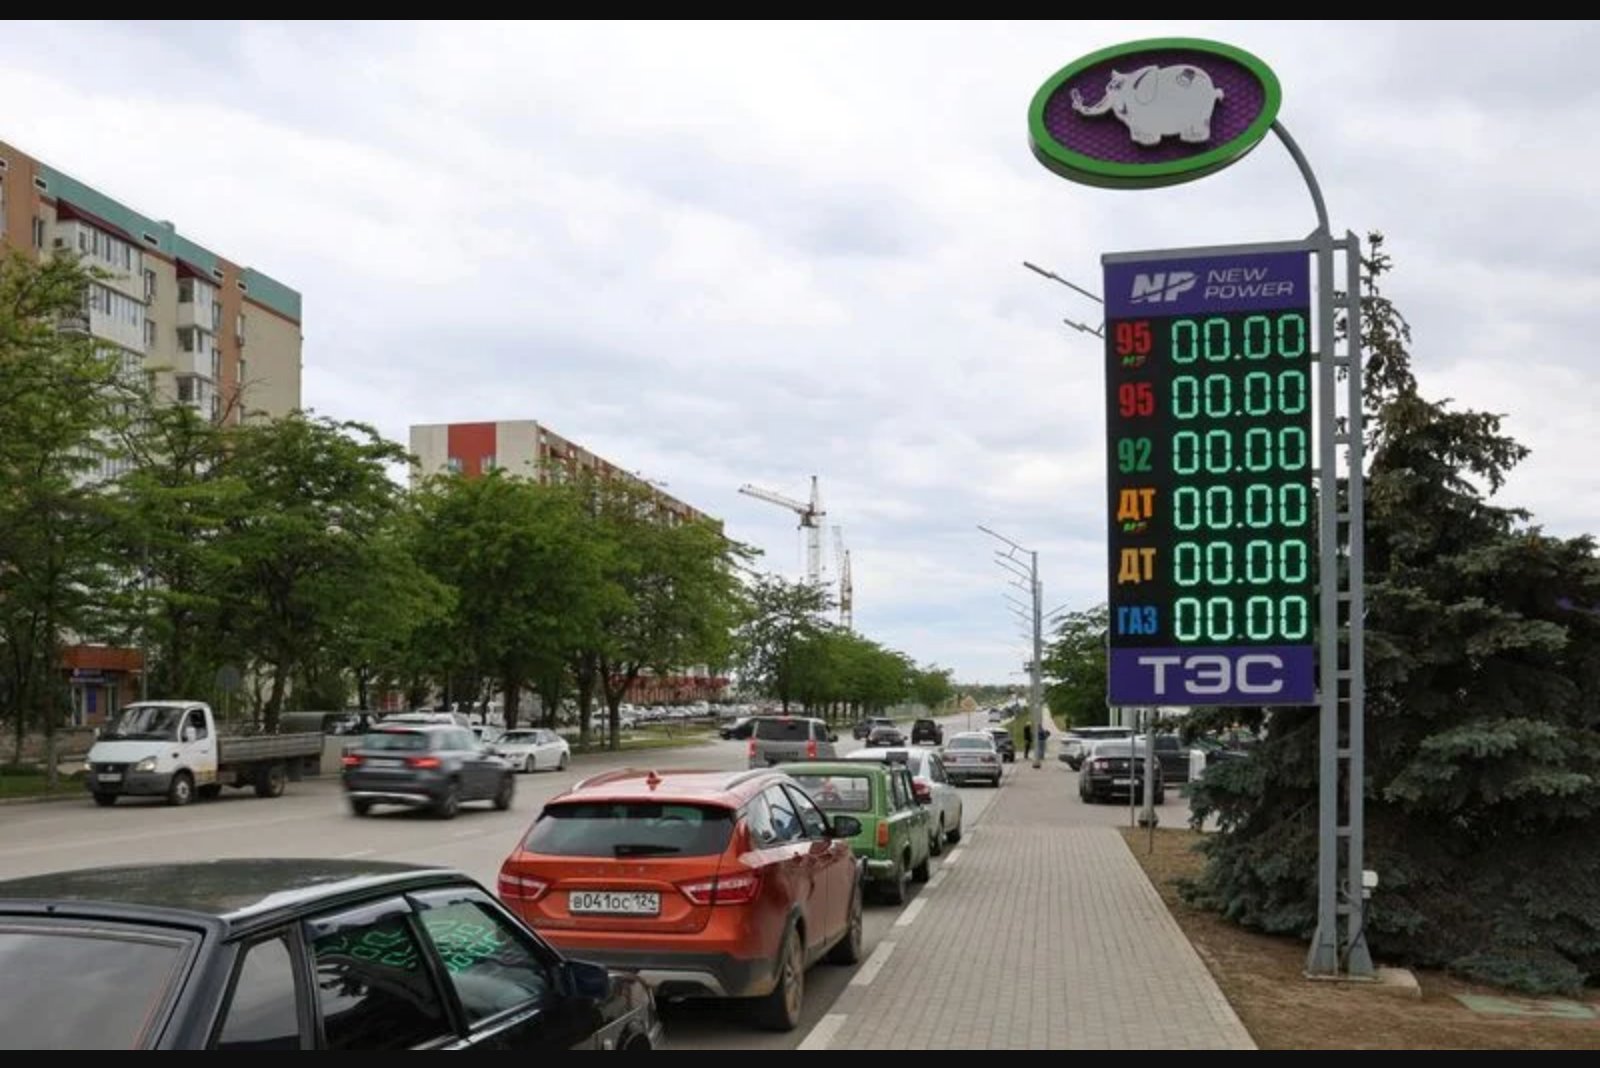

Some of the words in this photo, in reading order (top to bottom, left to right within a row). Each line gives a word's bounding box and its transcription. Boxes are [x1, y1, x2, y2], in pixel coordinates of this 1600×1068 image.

[1131, 272, 1198, 303] NP
[1204, 281, 1294, 299] POWER
[1207, 267, 1268, 283] NEW
[1116, 322, 1151, 354] 95
[1171, 314, 1304, 363] 00.00
[1119, 382, 1154, 417] 95
[1172, 370, 1305, 419] 00.00
[1117, 437, 1152, 473] 92
[1173, 427, 1305, 475] 00.00
[1117, 488, 1156, 521] ДТ
[1173, 484, 1306, 530] 00.00
[1117, 547, 1156, 584] ДТ
[1174, 540, 1307, 586] 00.00
[1117, 606, 1157, 635] ГАЗ
[1174, 596, 1307, 641] 00.00
[1138, 654, 1283, 695] ТЭС
